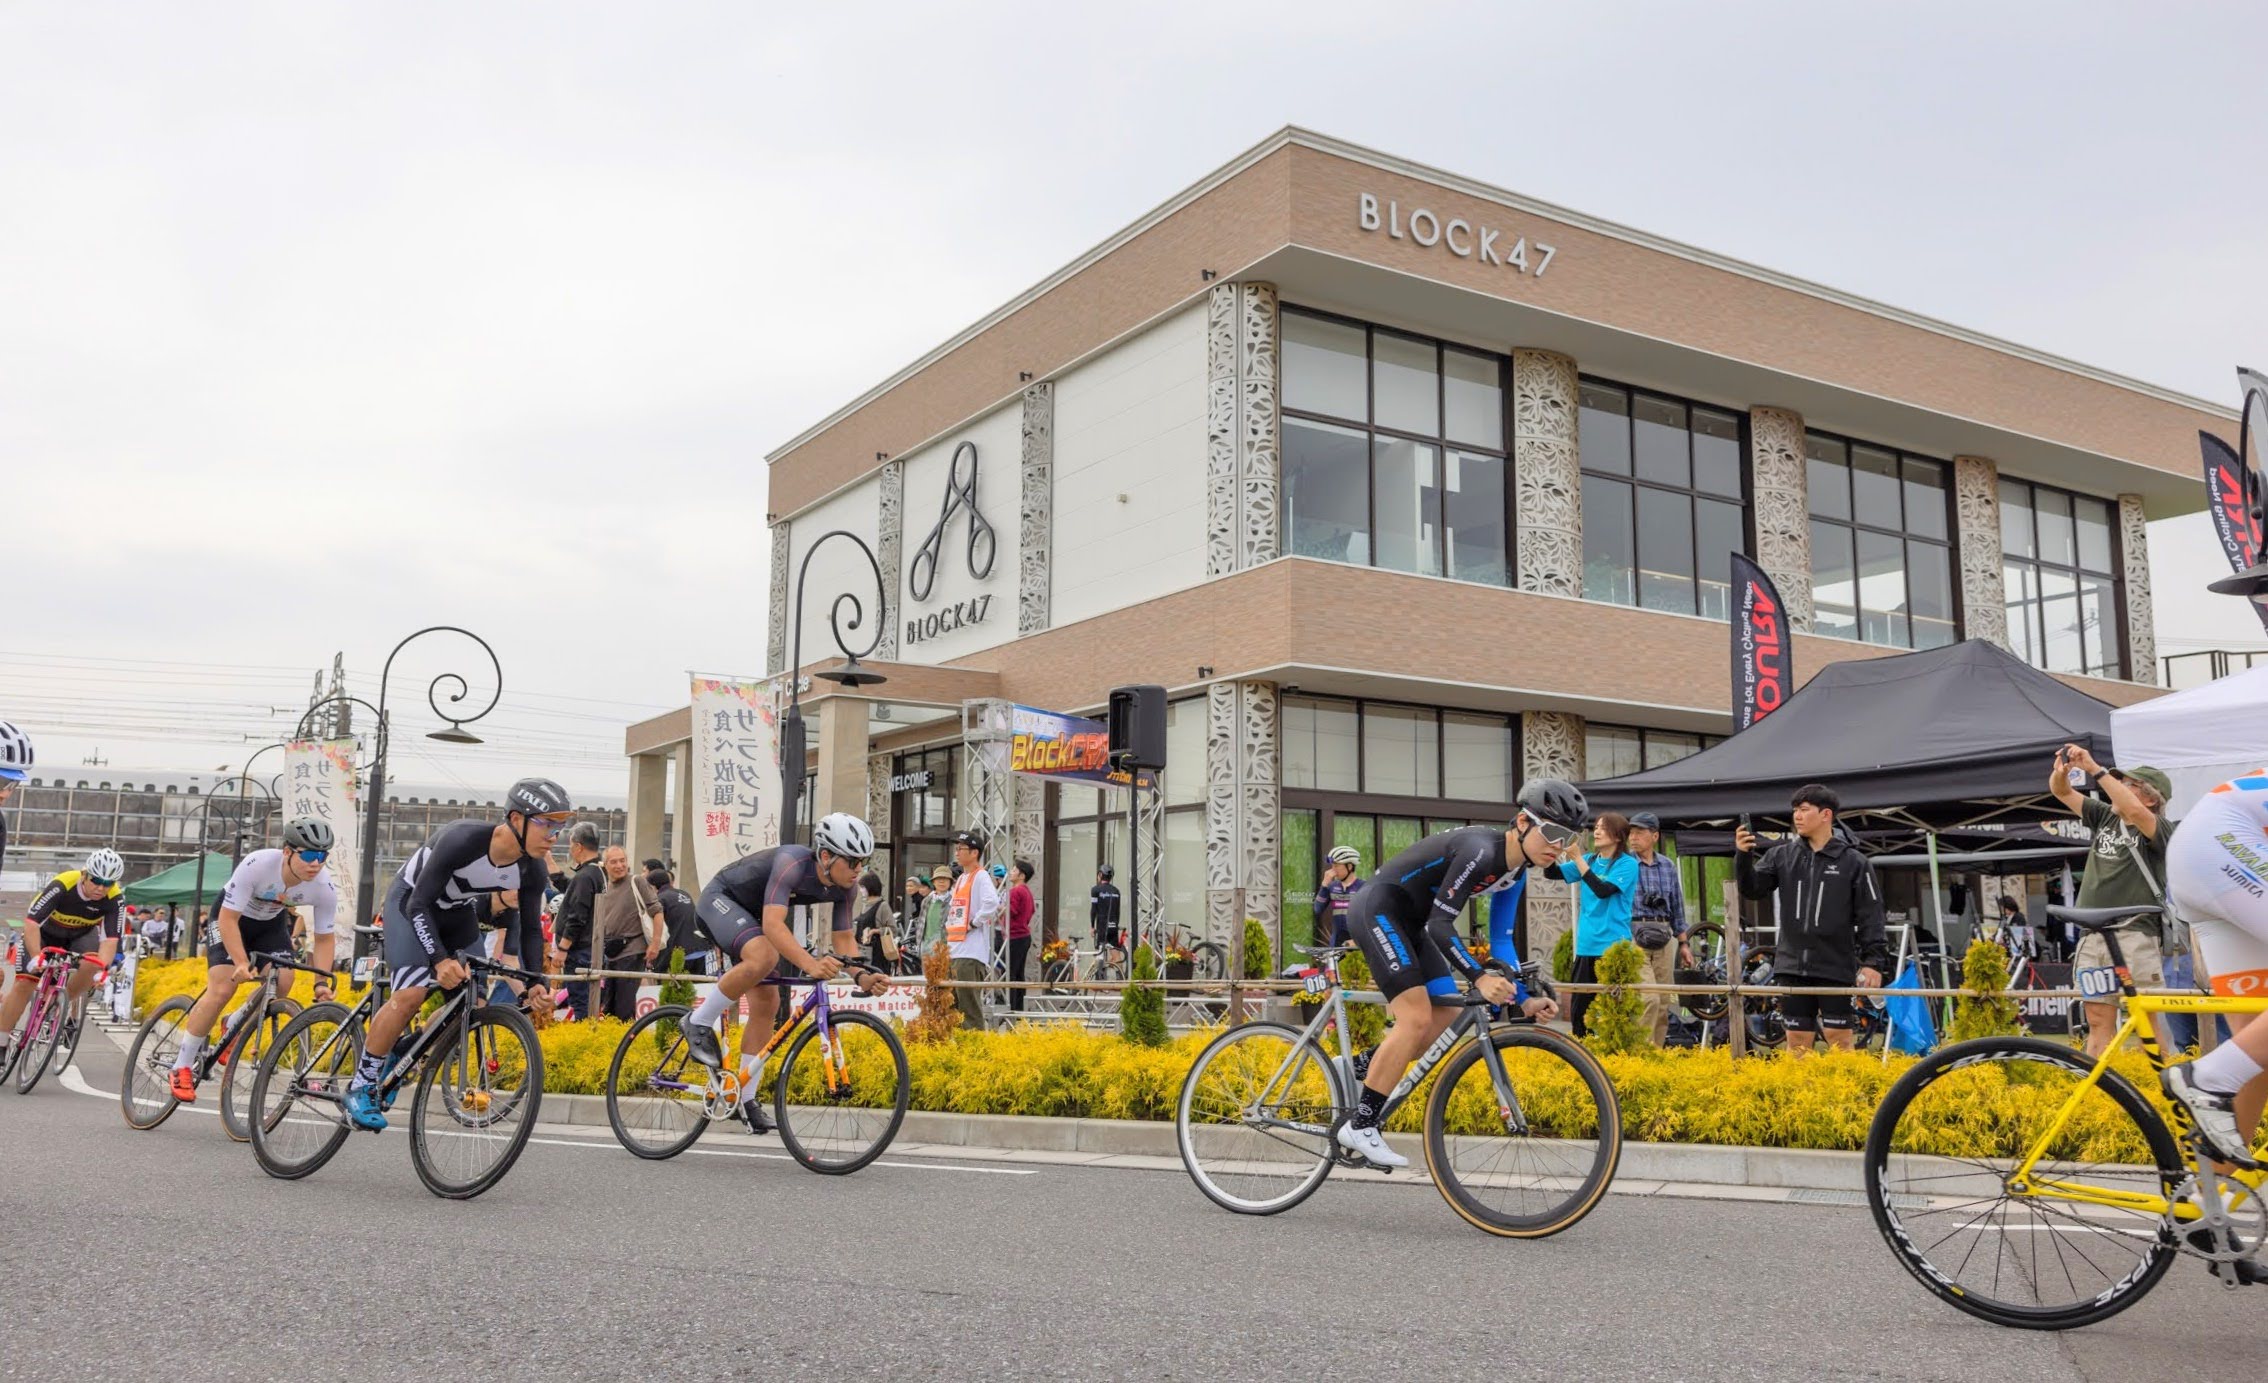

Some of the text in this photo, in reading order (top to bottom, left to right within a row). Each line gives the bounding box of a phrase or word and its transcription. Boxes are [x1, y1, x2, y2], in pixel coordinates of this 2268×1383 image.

[1360, 192, 1556, 277] BLOCK47
[907, 594, 991, 645] BLOCK47
[888, 771, 929, 792] WELCOME
[1453, 860, 1477, 890] vittoria
[413, 913, 436, 955] Velobike
[1306, 974, 1327, 994] 016
[2081, 968, 2115, 995] 007
[878, 1000, 914, 1010] Match
[1387, 1027, 1458, 1102] cinelli
